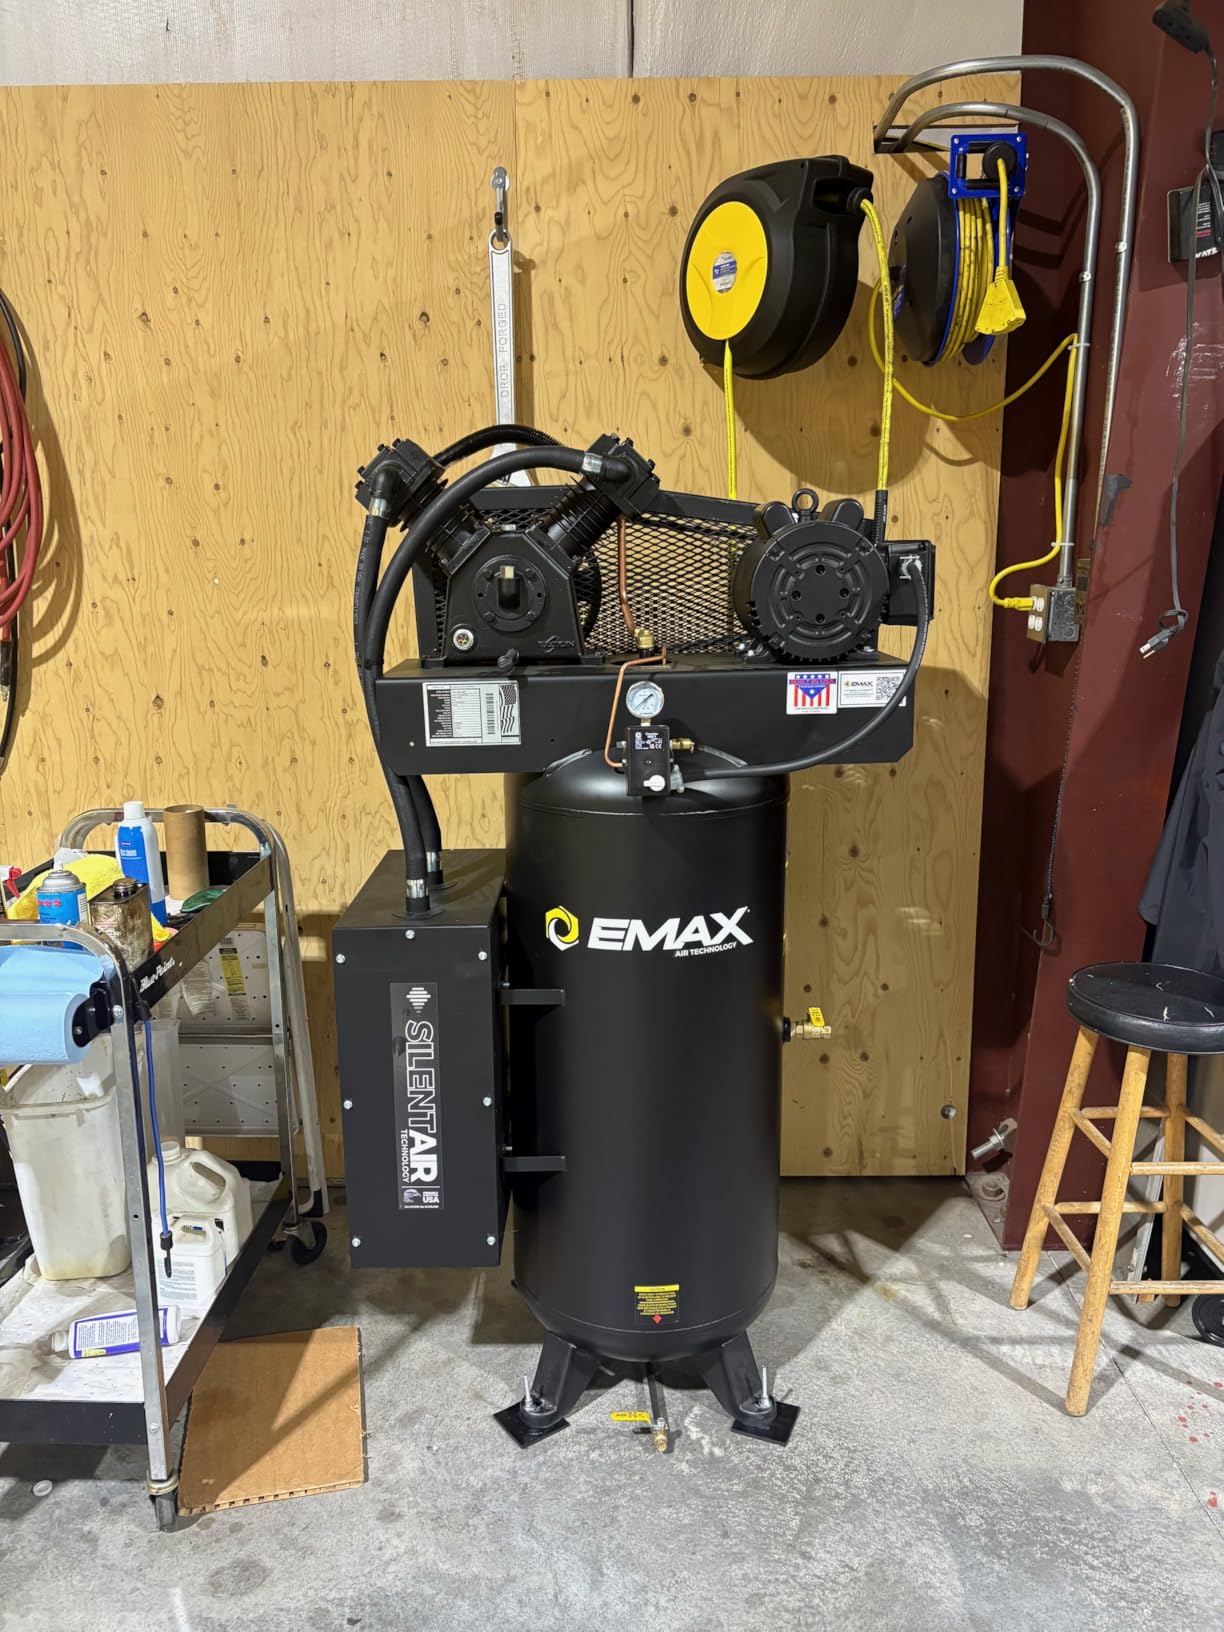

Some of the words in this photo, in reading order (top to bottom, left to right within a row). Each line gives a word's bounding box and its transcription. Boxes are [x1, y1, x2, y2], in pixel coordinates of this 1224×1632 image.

[498, 304, 508, 353] FORGED
[499, 364, 509, 397] DROP
[588, 906, 753, 950] EMAX
[675, 949, 689, 958] AIR
[690, 942, 737, 955] TECHNOLOGY
[400, 1129, 410, 1183] TECHNOLOGY
